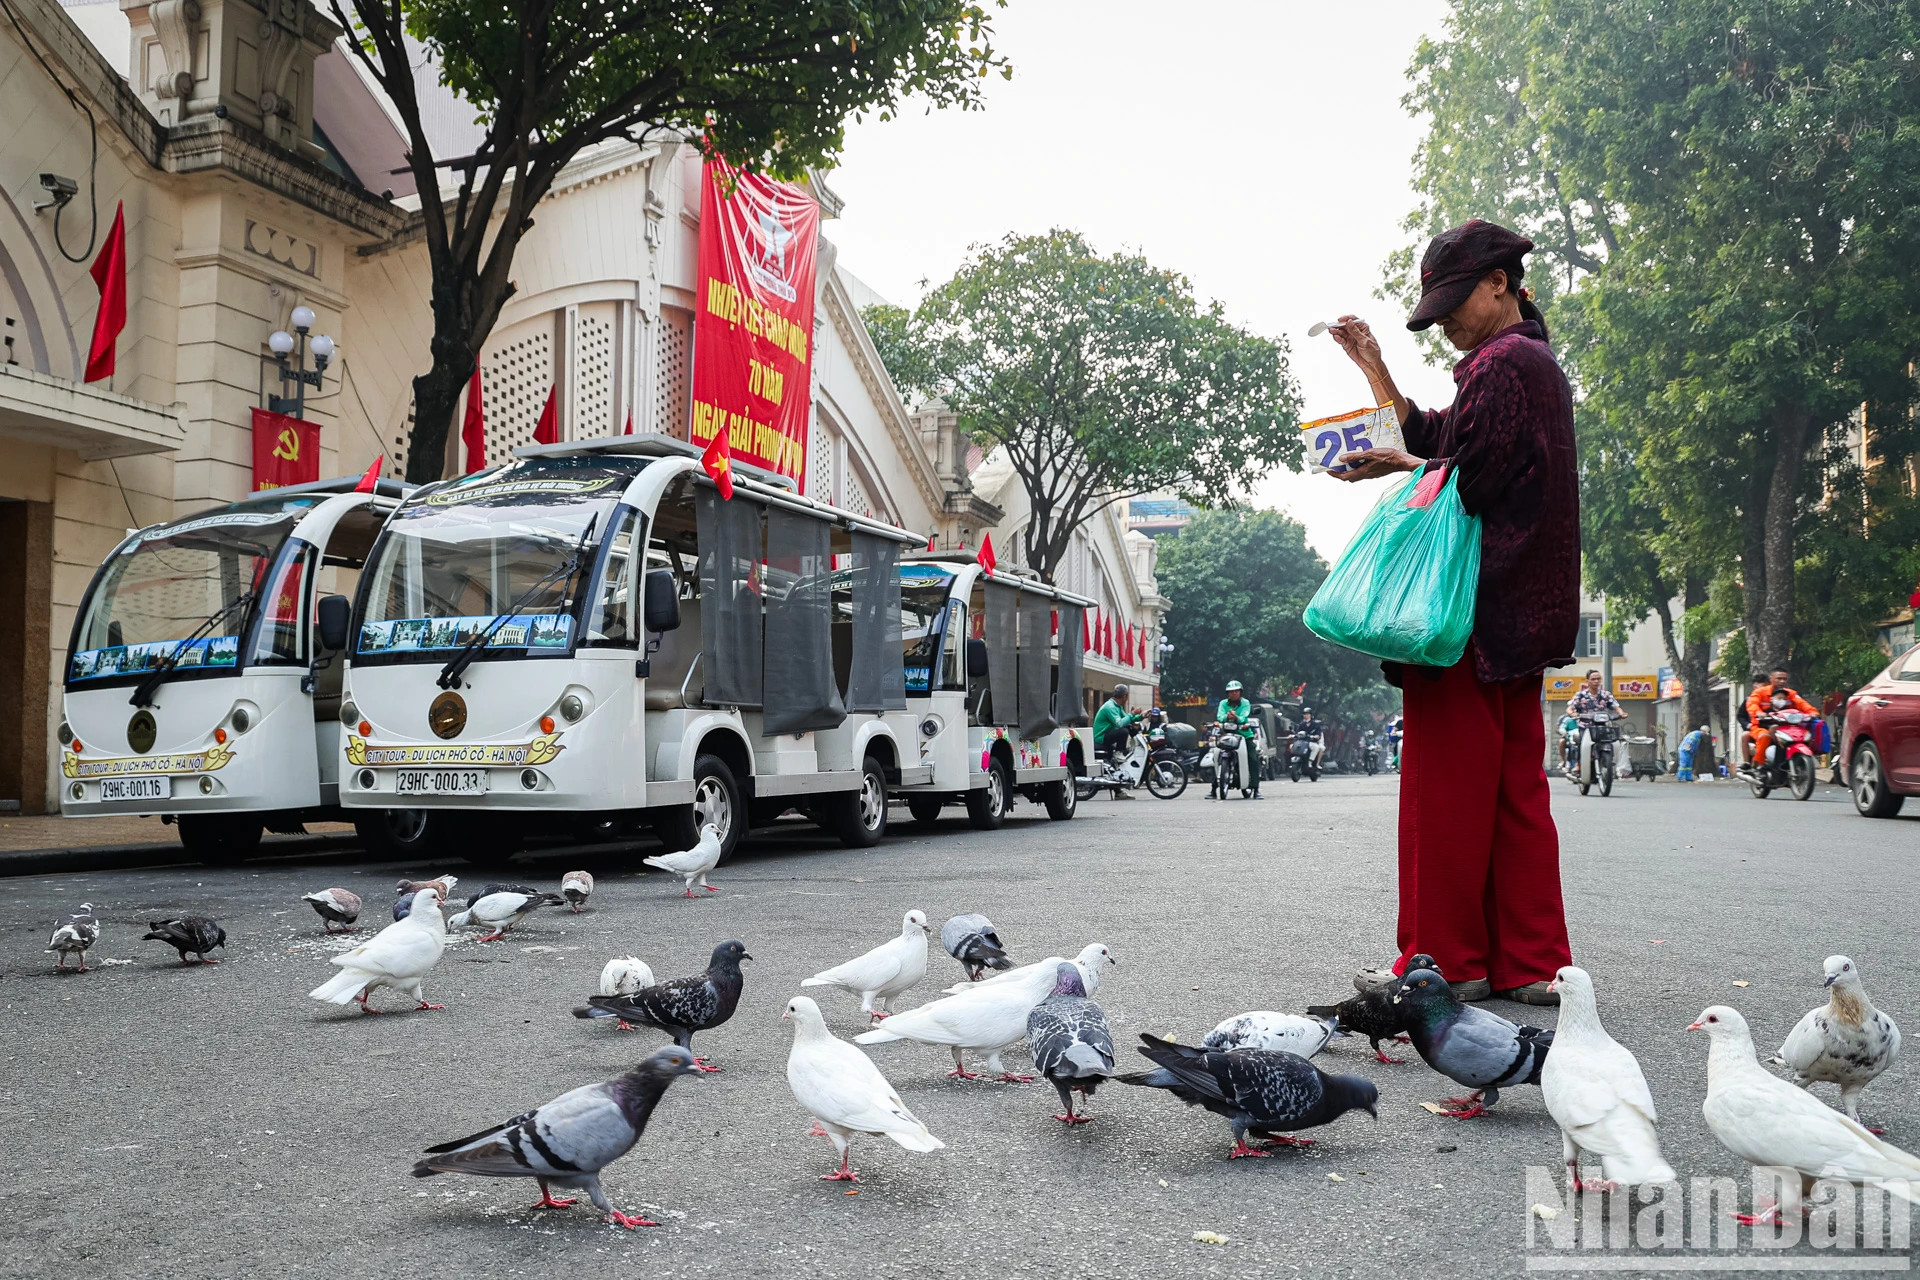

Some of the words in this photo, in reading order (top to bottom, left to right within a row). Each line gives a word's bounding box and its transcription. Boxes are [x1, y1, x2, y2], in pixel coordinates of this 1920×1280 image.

[707, 276, 742, 331] NHIỆT
[764, 307, 789, 351] CHÀO
[748, 358, 762, 396] 70
[762, 361, 784, 406] NĂM
[729, 405, 753, 454] GIẢI
[1315, 423, 1374, 473] 25
[92, 763, 109, 774] TOUR
[112, 761, 123, 772] DU
[175, 755, 187, 769] HÀ
[188, 755, 205, 772] NỘI
[366, 750, 384, 763] CITY
[384, 750, 407, 762] TOUR
[412, 750, 425, 761] DU
[425, 749, 447, 765] LỊCH
[447, 746, 471, 761] PHỐ
[491, 746, 505, 761] HÀ
[507, 746, 526, 765] NỘI
